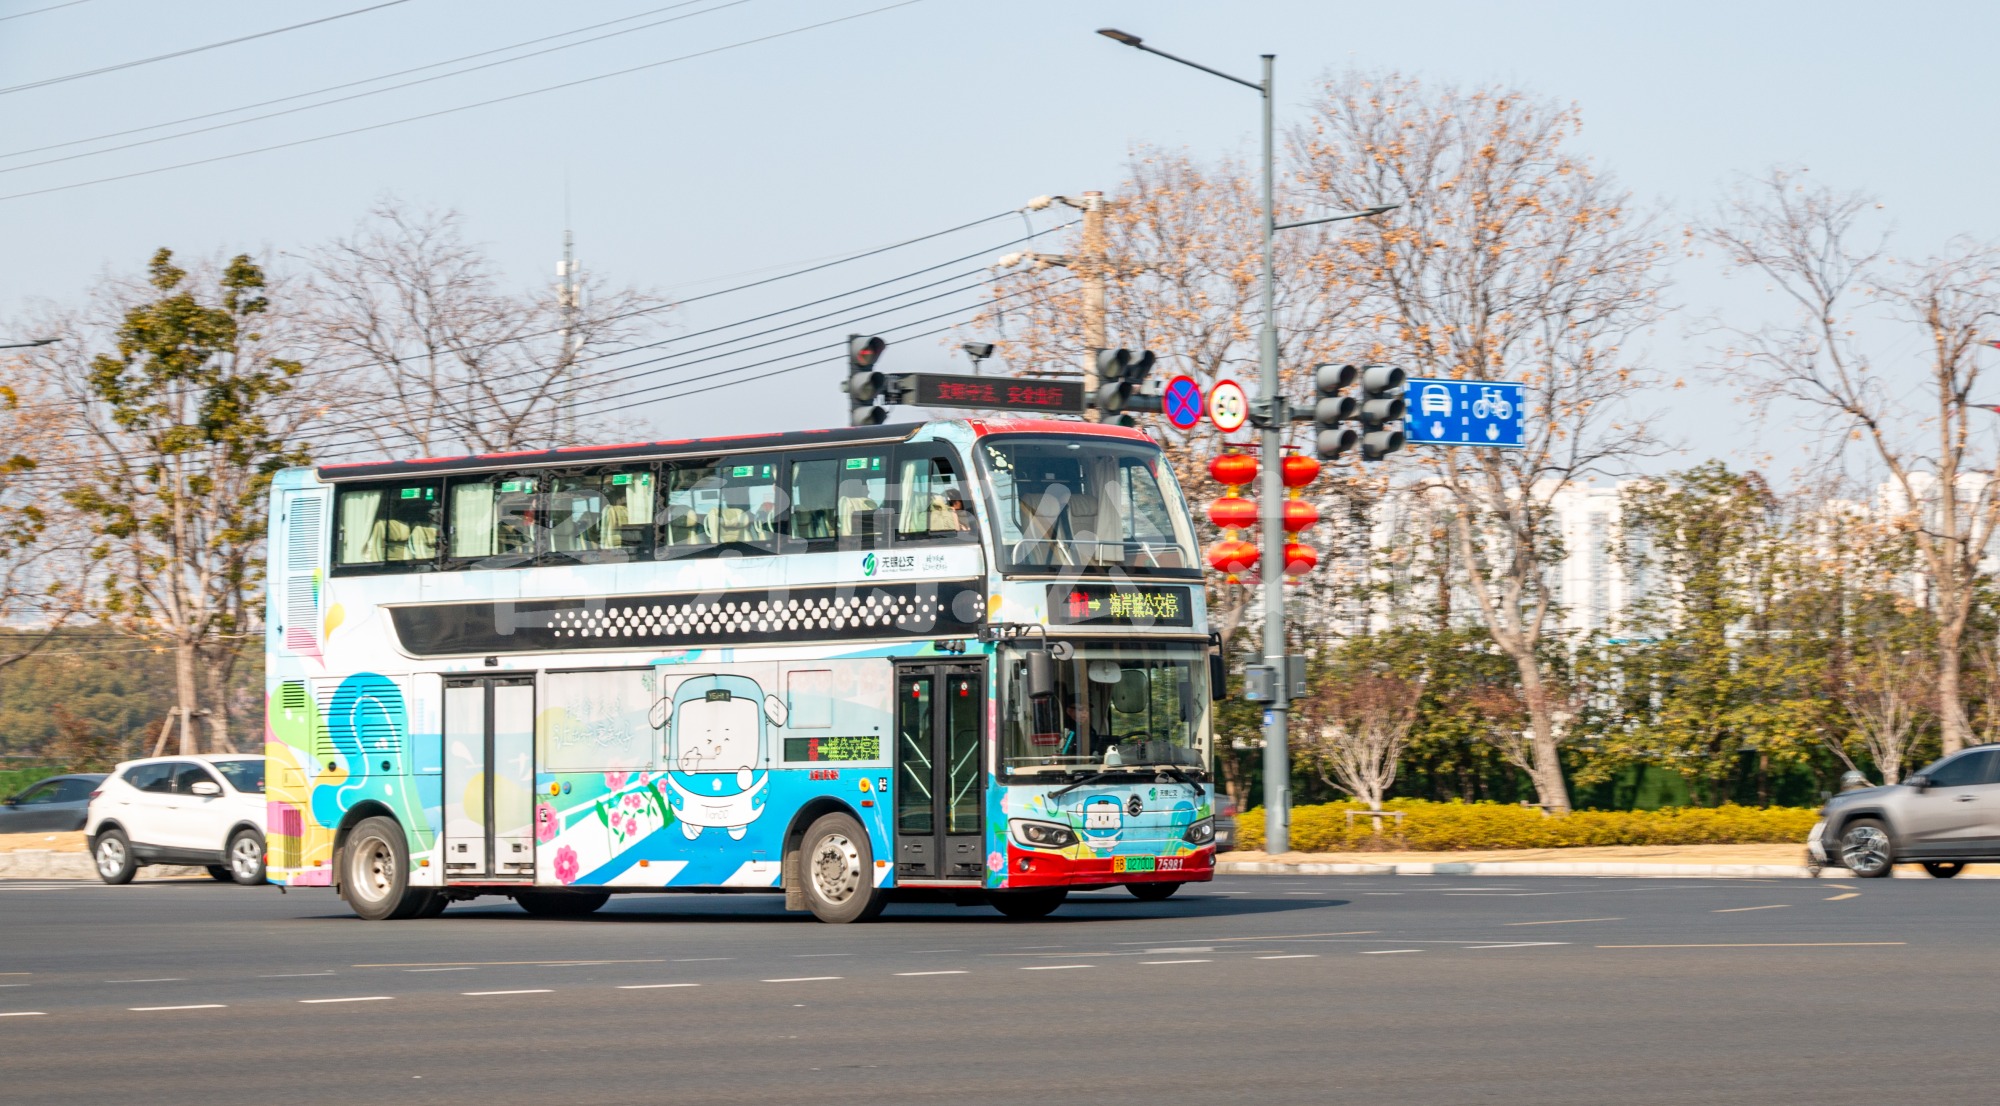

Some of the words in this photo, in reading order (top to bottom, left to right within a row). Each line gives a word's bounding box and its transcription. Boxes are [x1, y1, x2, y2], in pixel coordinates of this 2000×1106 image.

[882, 556, 914, 568] 无锡公交
[1157, 858, 1184, 870] 75981
